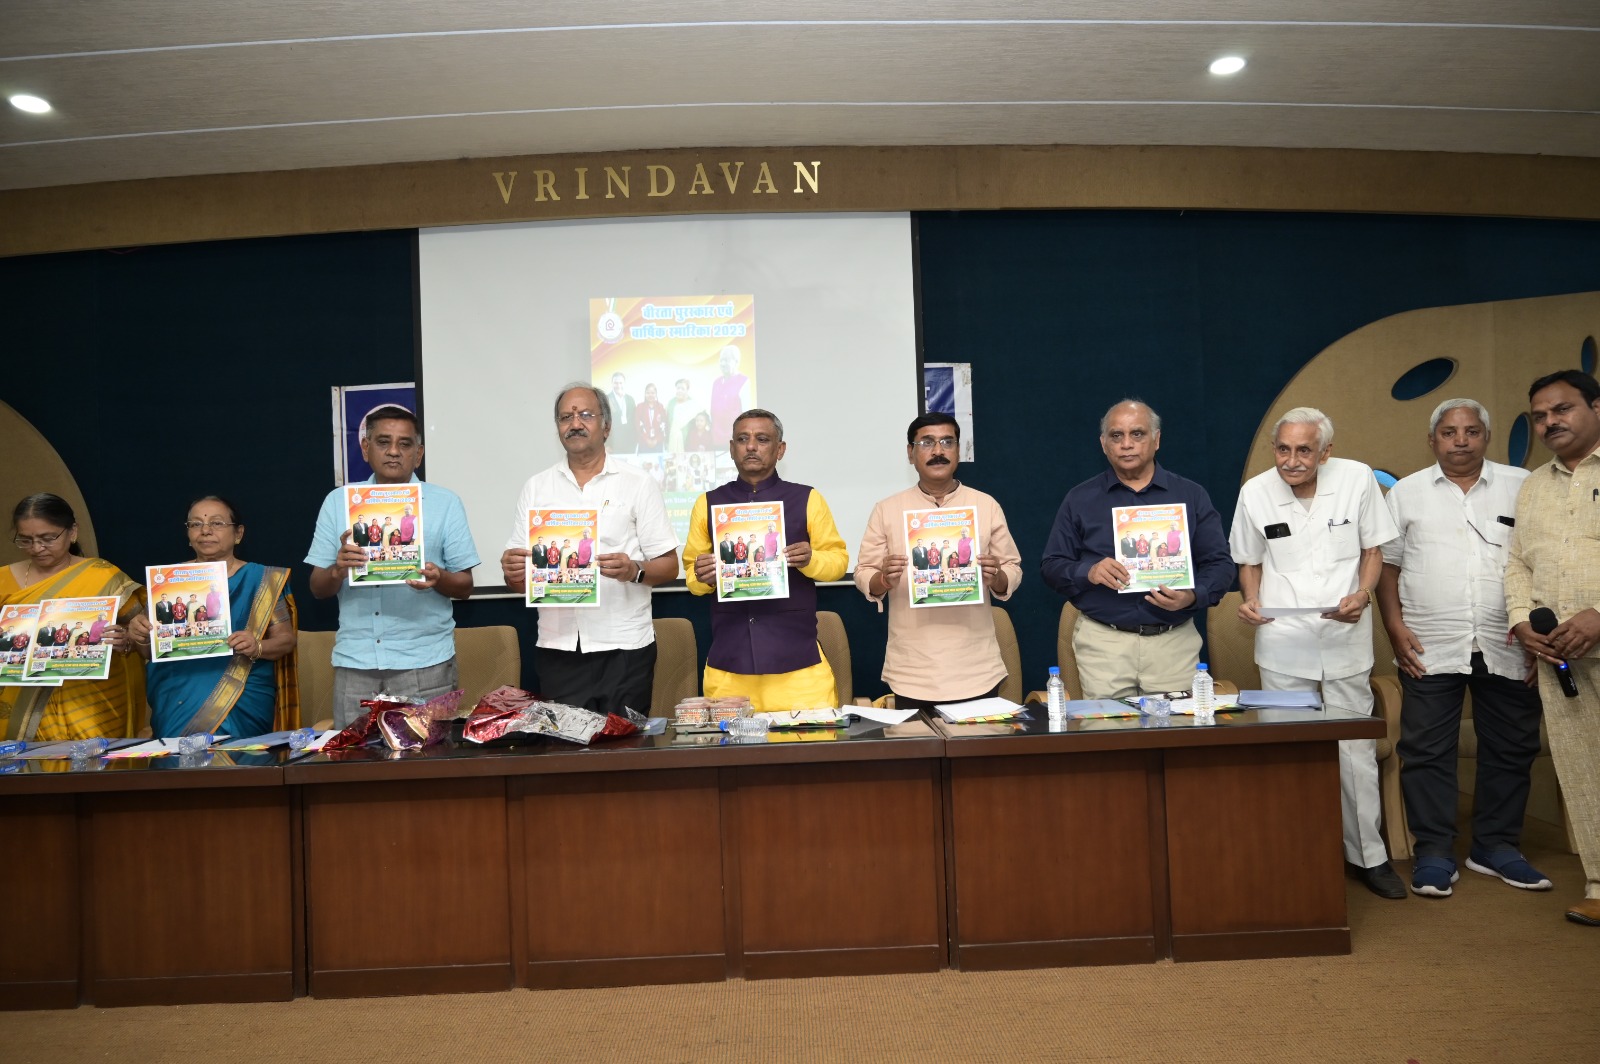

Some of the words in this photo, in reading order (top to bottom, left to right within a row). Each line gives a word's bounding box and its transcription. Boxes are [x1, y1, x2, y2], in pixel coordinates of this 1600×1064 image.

[493, 161, 820, 203] VRINDAVAN
[642, 304, 672, 319] वीरता
[674, 304, 715, 321] पुरस्कार
[716, 301, 733, 318] एवं
[630, 323, 667, 339] वार्षिक
[668, 323, 712, 338] स्मारिका
[713, 324, 746, 337] 2023
